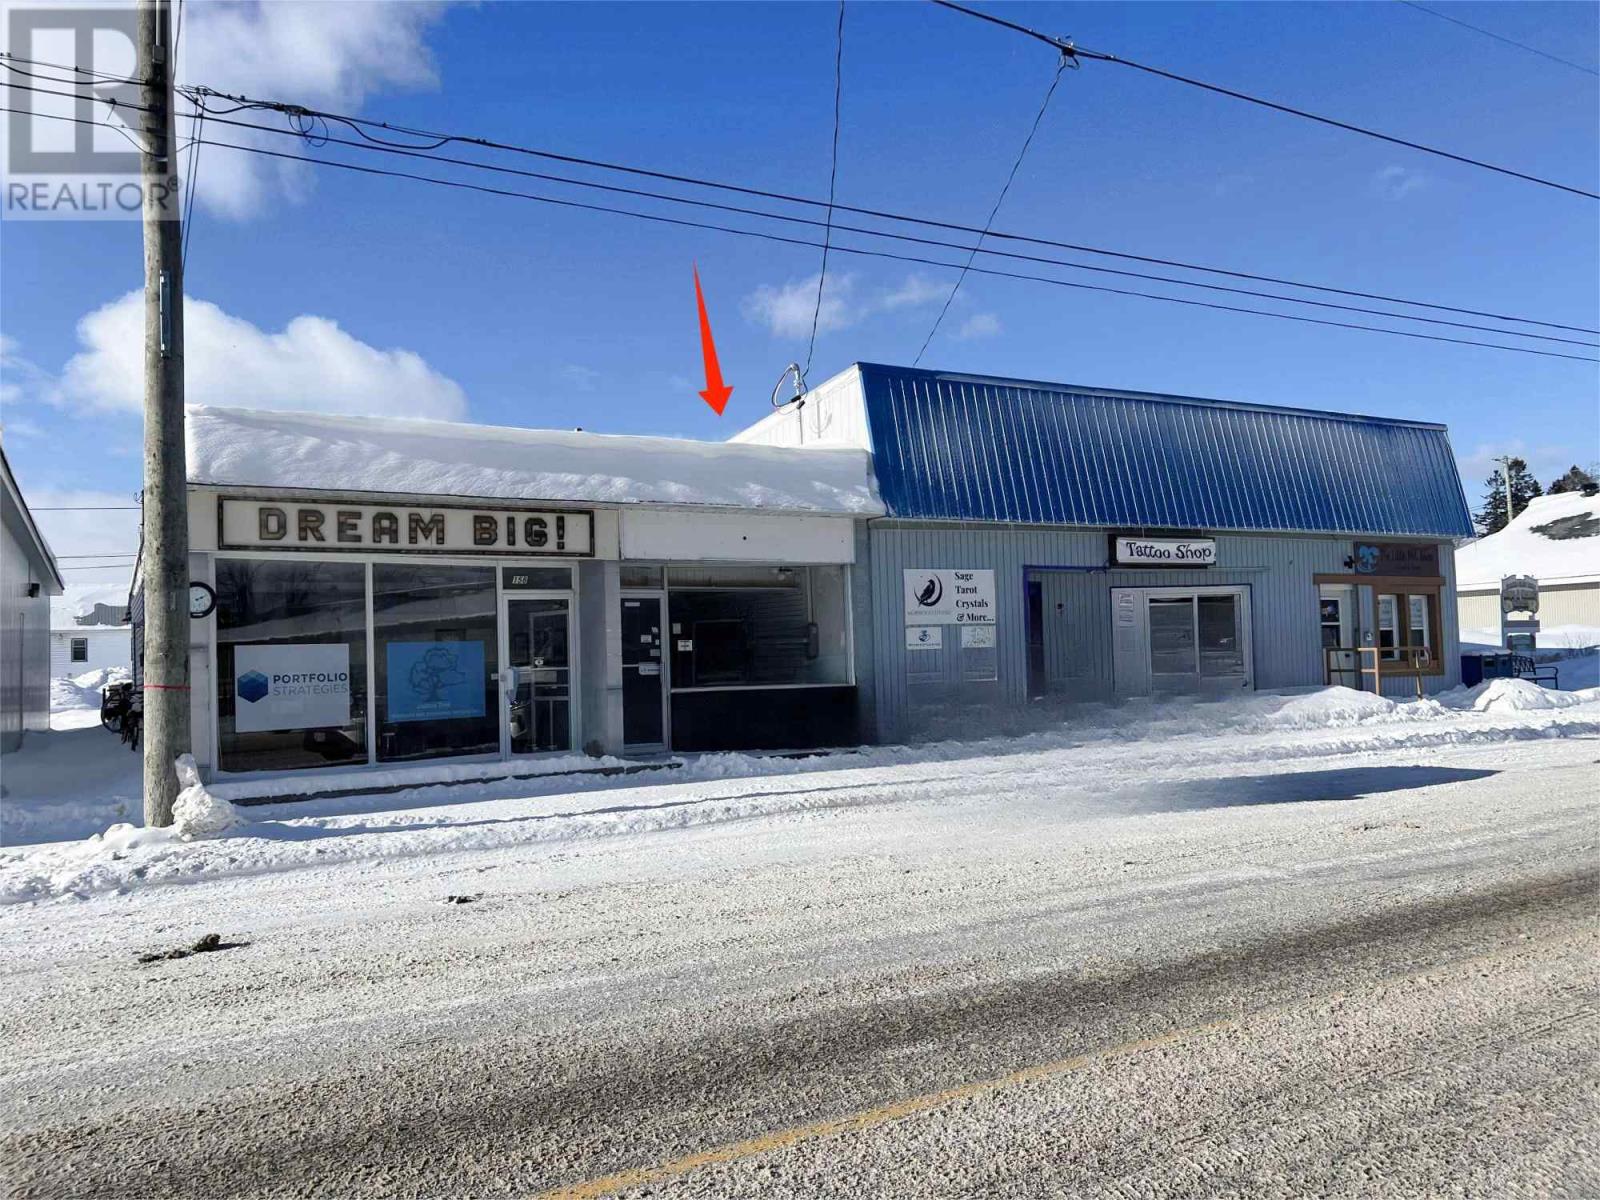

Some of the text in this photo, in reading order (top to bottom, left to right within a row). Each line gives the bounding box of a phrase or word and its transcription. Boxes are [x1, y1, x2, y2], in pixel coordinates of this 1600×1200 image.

[258, 507, 566, 551] DREAM BIG!
[1126, 542, 1212, 562] Tattoo Shop
[954, 571, 974, 581] Sage
[954, 585, 978, 594] Tarot
[955, 599, 989, 609] Crystals
[956, 613, 964, 622] &
[273, 672, 348, 684] PORTFOLIO
[273, 683, 348, 697] STRATEGIES
